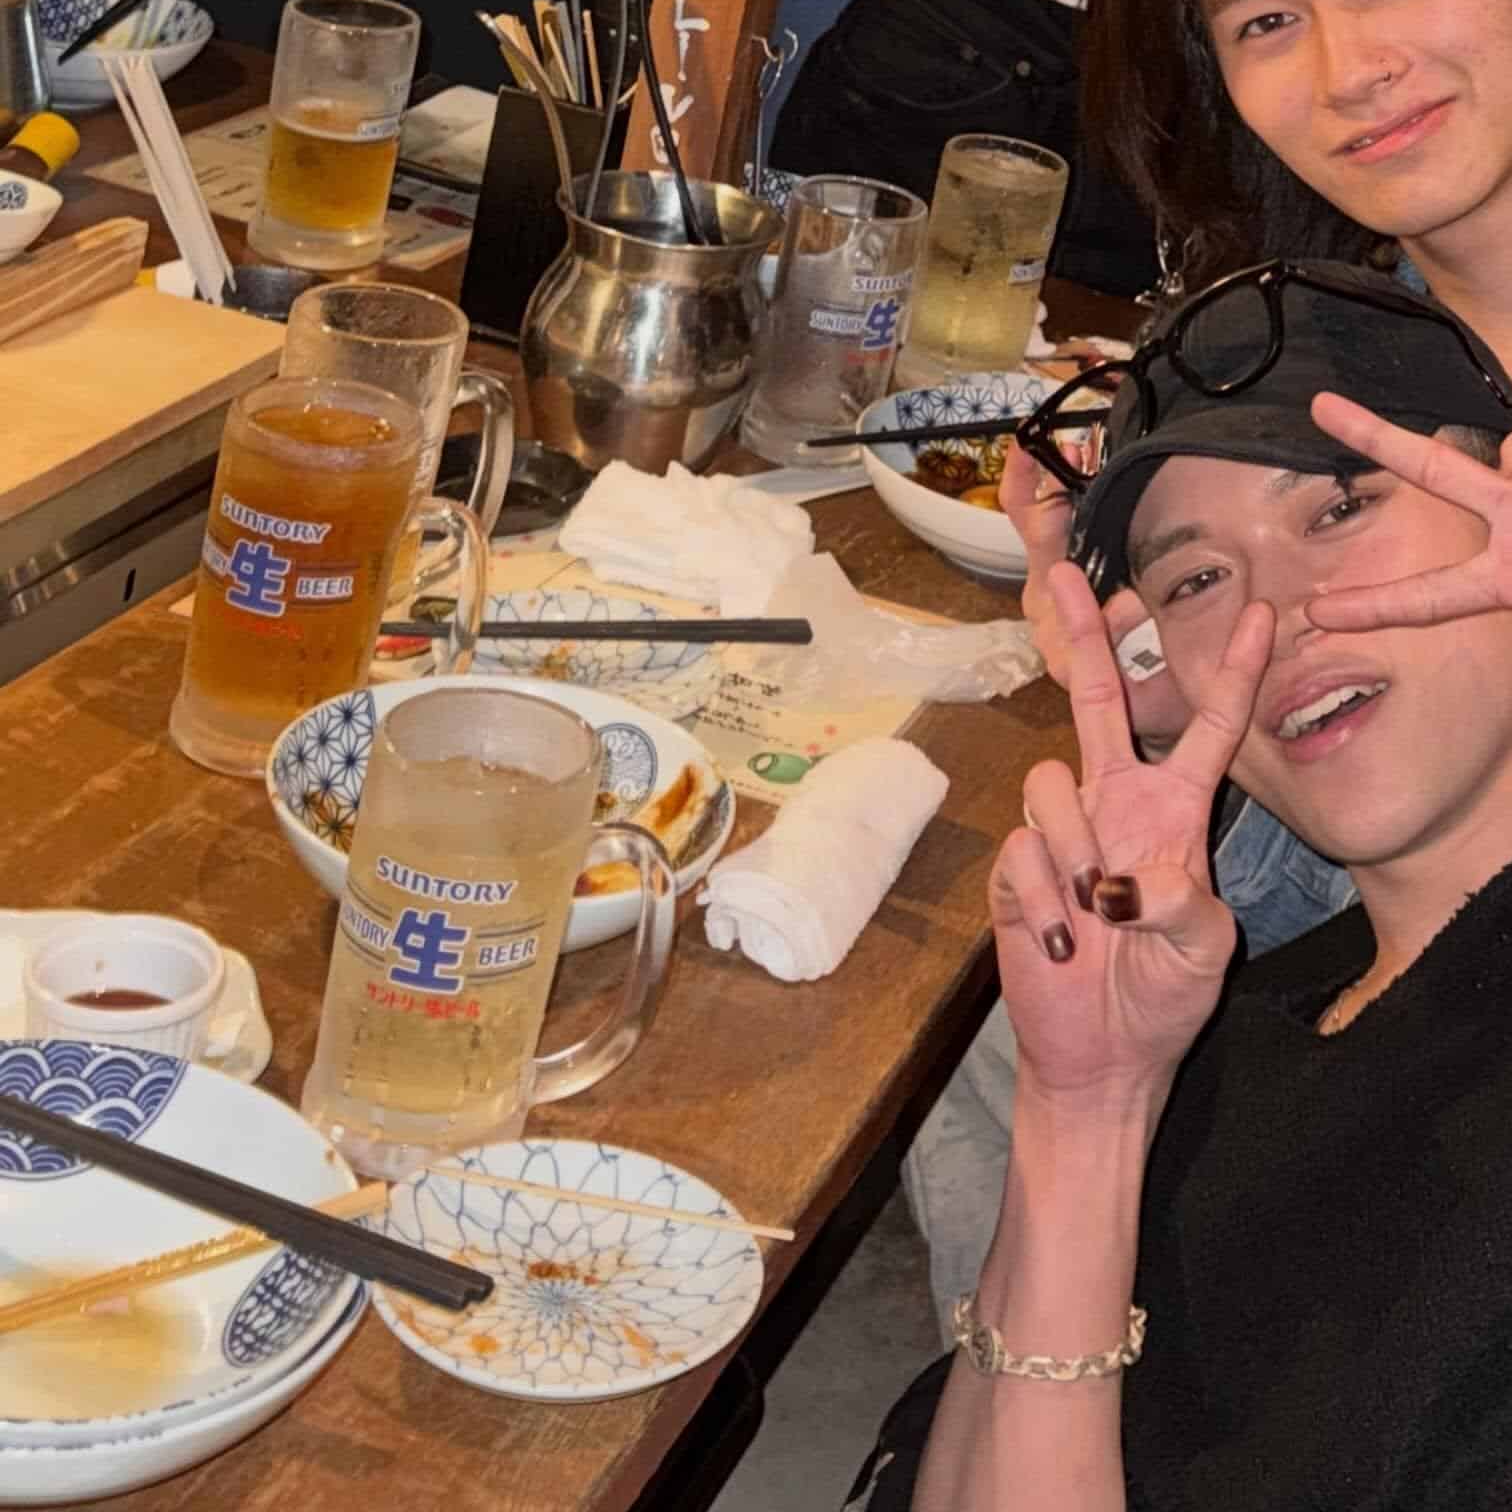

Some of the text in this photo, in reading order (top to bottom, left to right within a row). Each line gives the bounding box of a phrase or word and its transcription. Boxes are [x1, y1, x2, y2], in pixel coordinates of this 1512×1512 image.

[222, 495, 331, 544] SUNTORY
[227, 540, 289, 616] 生
[296, 577, 353, 598] BEER
[376, 856, 516, 903] SUNTORY
[390, 909, 469, 993] 生
[478, 938, 536, 966] BEER
